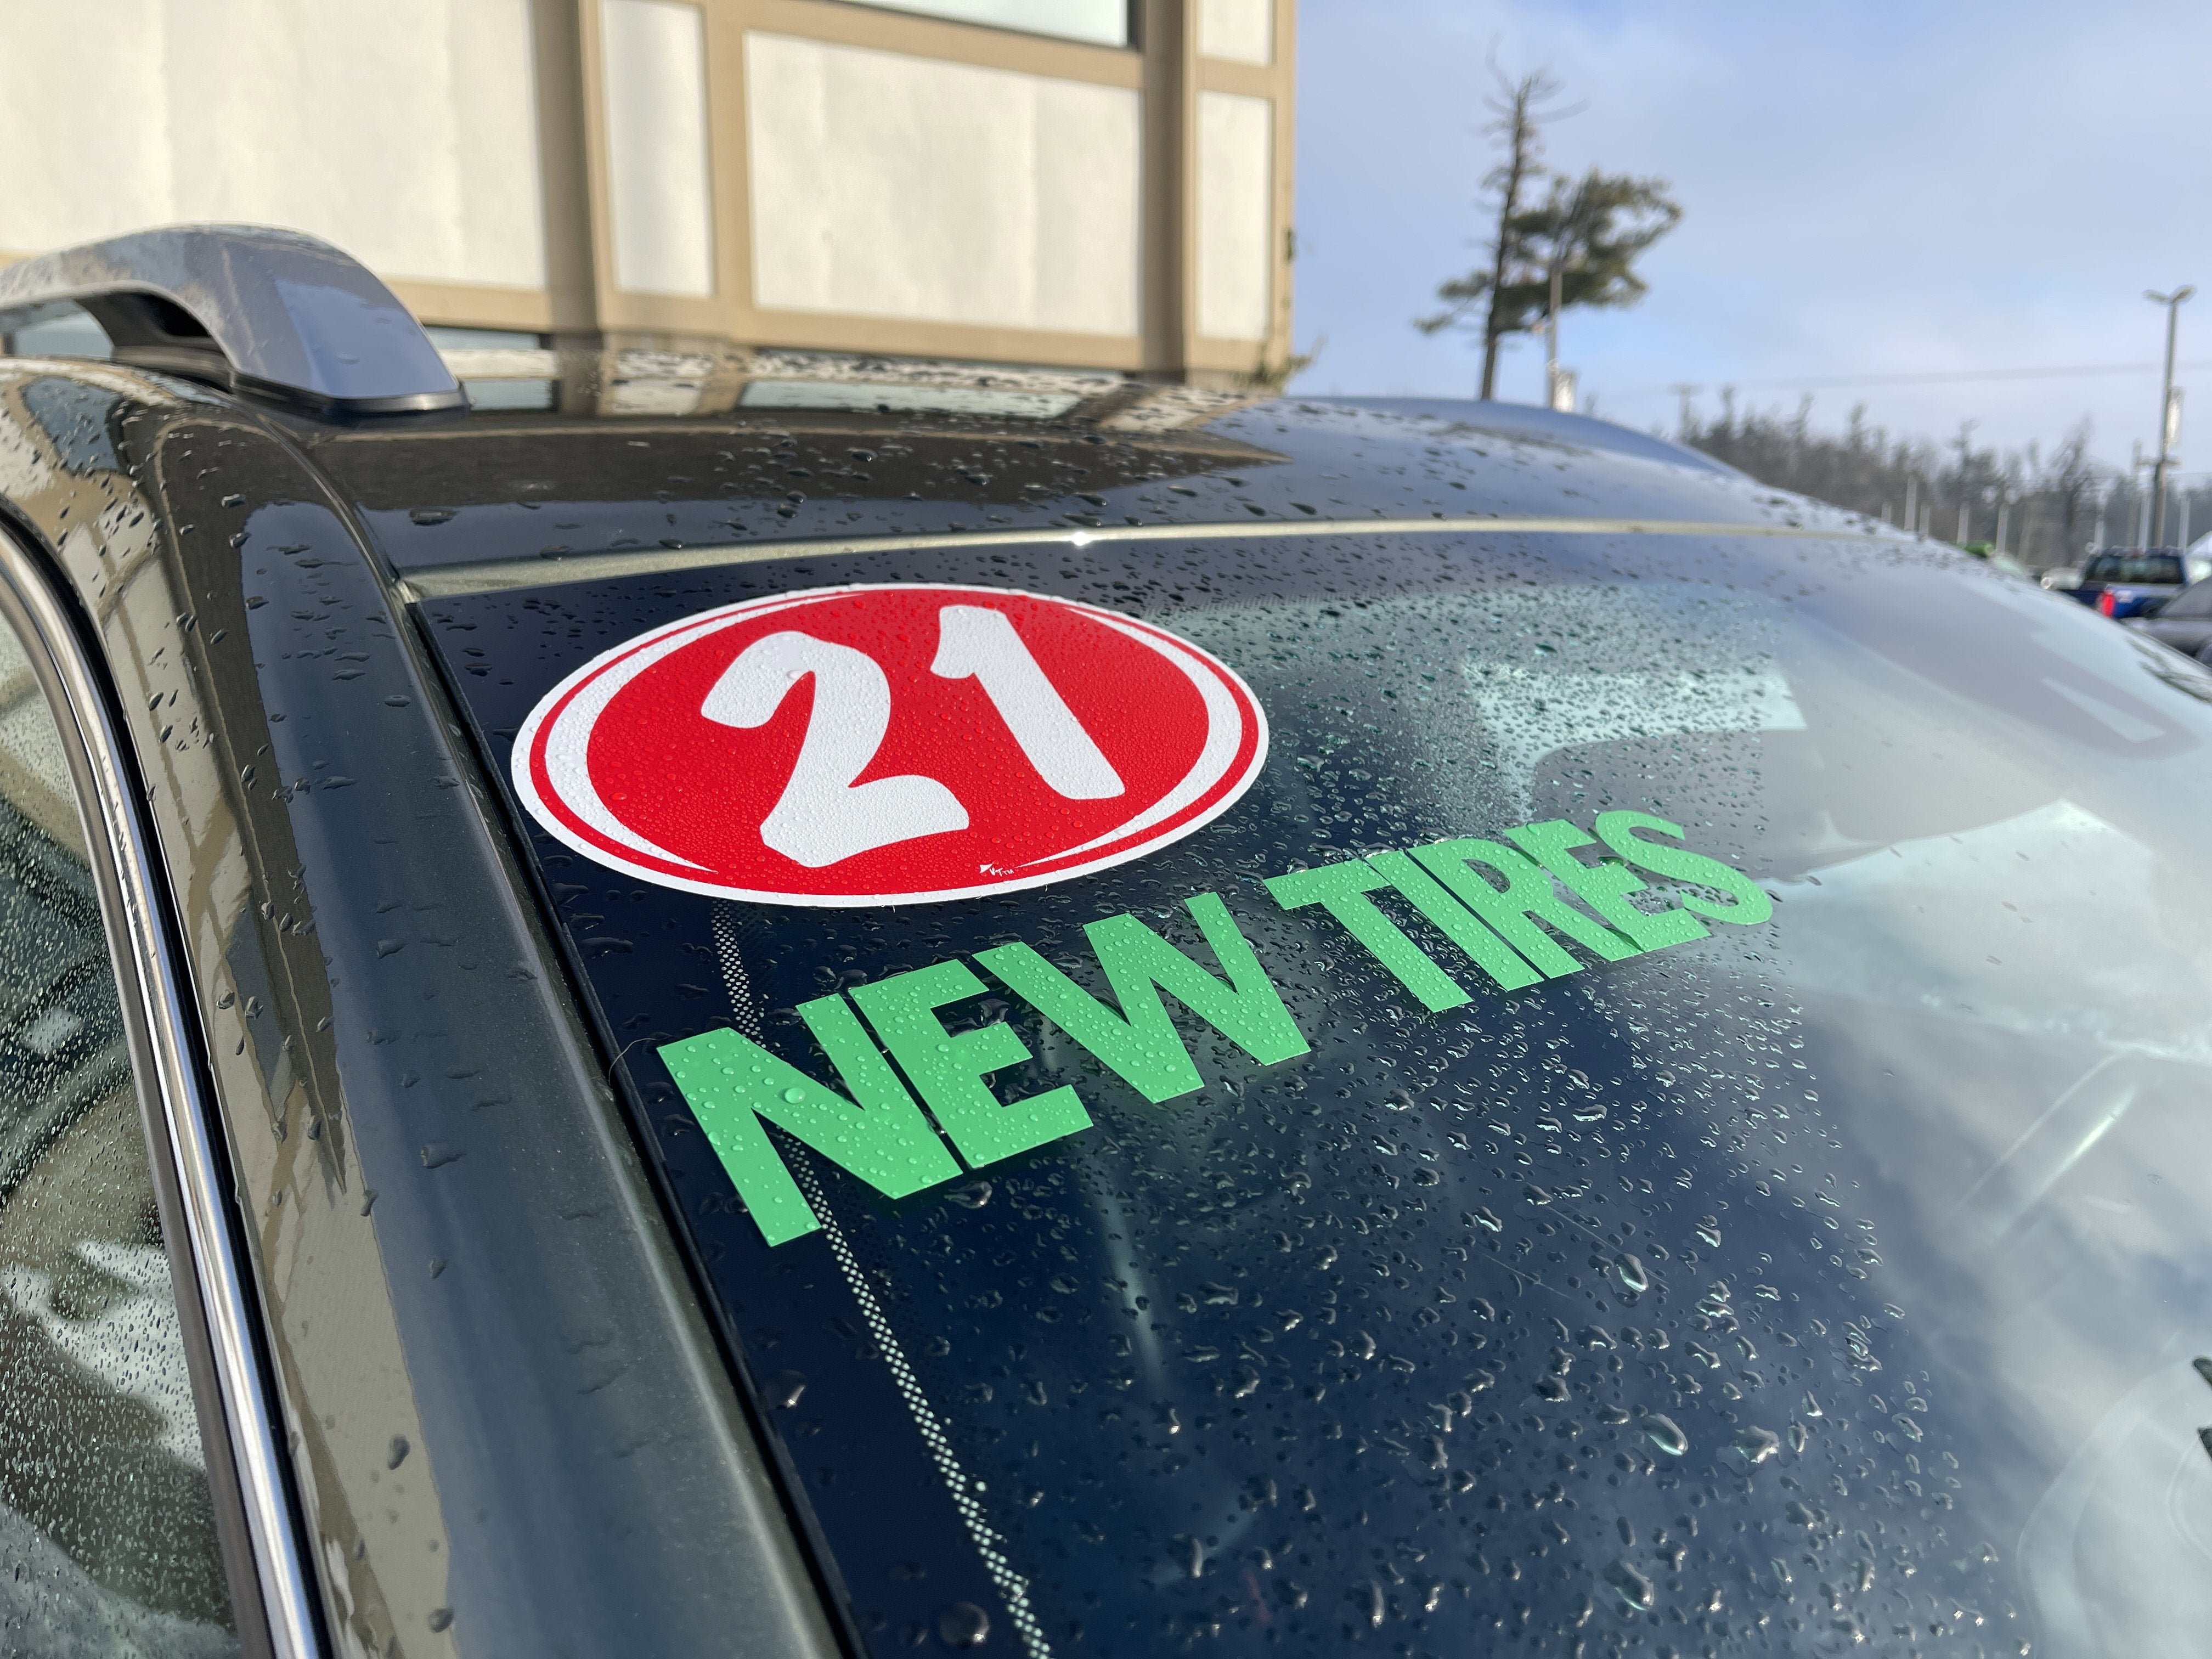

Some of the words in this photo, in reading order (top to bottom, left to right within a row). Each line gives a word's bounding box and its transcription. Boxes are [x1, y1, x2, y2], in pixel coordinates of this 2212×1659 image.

[701, 605, 1126, 867] 21
[657, 891, 1311, 1247] NEW
[1263, 810, 1773, 1012] TIRES
